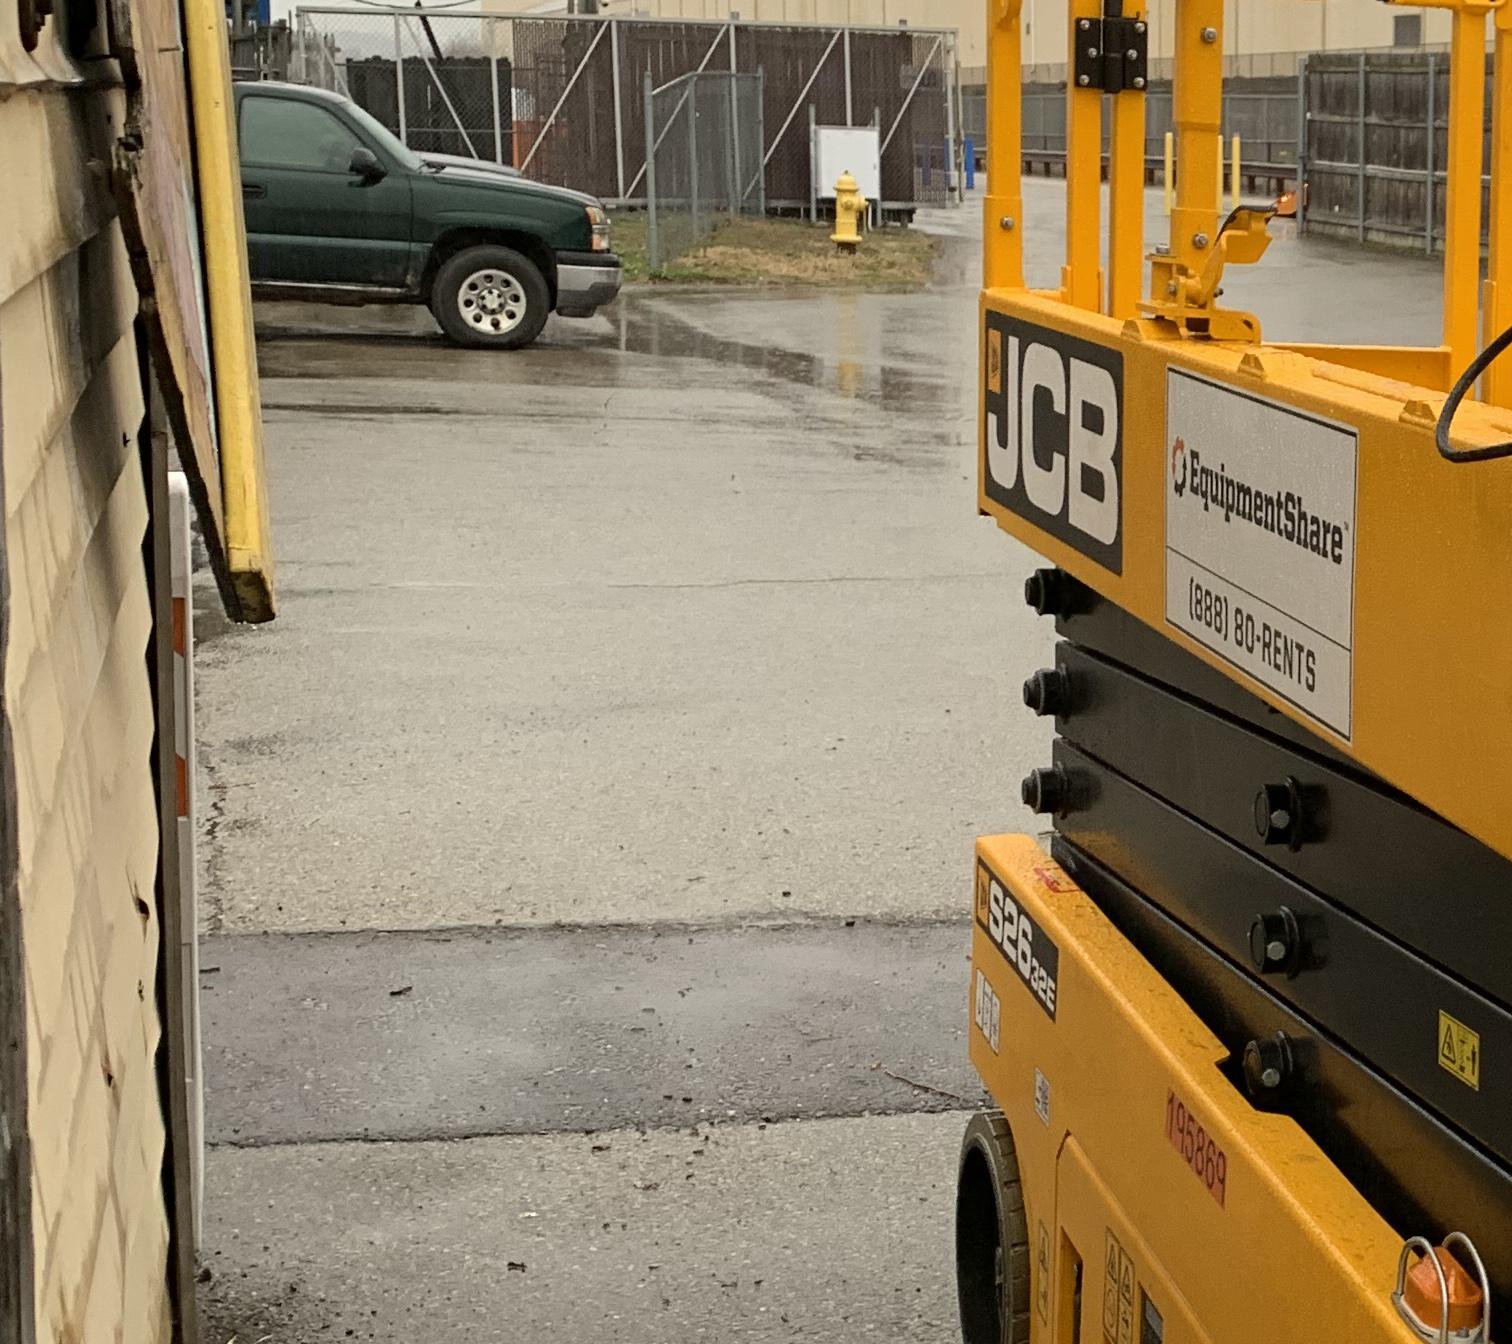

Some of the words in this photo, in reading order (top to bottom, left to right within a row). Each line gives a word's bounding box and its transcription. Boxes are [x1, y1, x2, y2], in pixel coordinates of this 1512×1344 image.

[987, 335, 1118, 546] JCB
[1190, 449, 1343, 565] EquipmentShare
[1189, 576, 1228, 641] (888)
[1234, 607, 1316, 693] 80-RENTS
[1168, 1091, 1226, 1209] 195869
